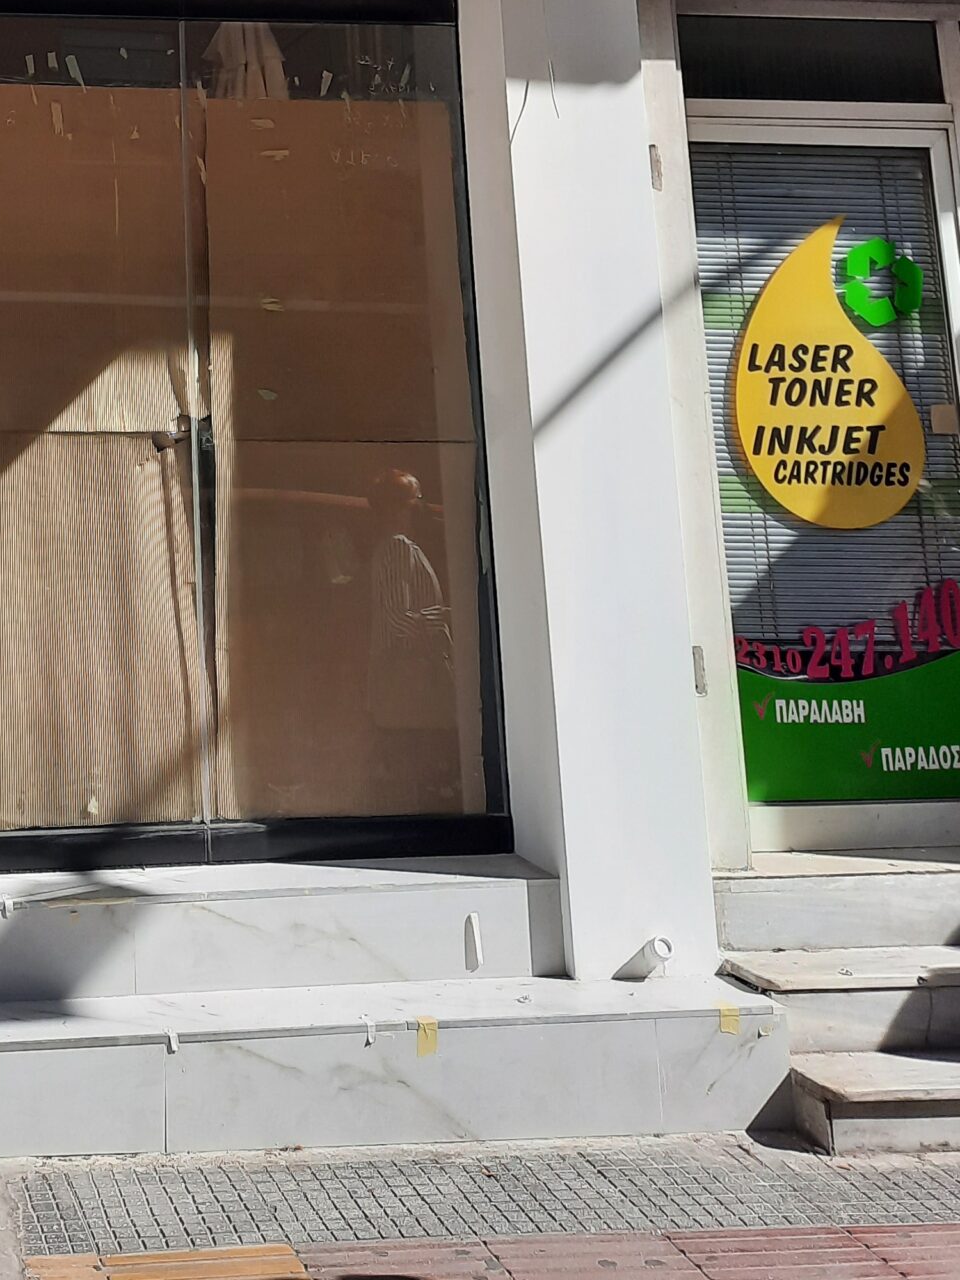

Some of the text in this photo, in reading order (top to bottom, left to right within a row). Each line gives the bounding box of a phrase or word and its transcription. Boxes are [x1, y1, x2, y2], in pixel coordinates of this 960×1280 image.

[747, 343, 854, 373] LASER
[768, 376, 878, 408] TONER
[752, 424, 886, 456] INKJET
[773, 459, 911, 487] CARTRIDGES
[775, 699, 866, 723] ΠΑΡΑΛΑΒΗ
